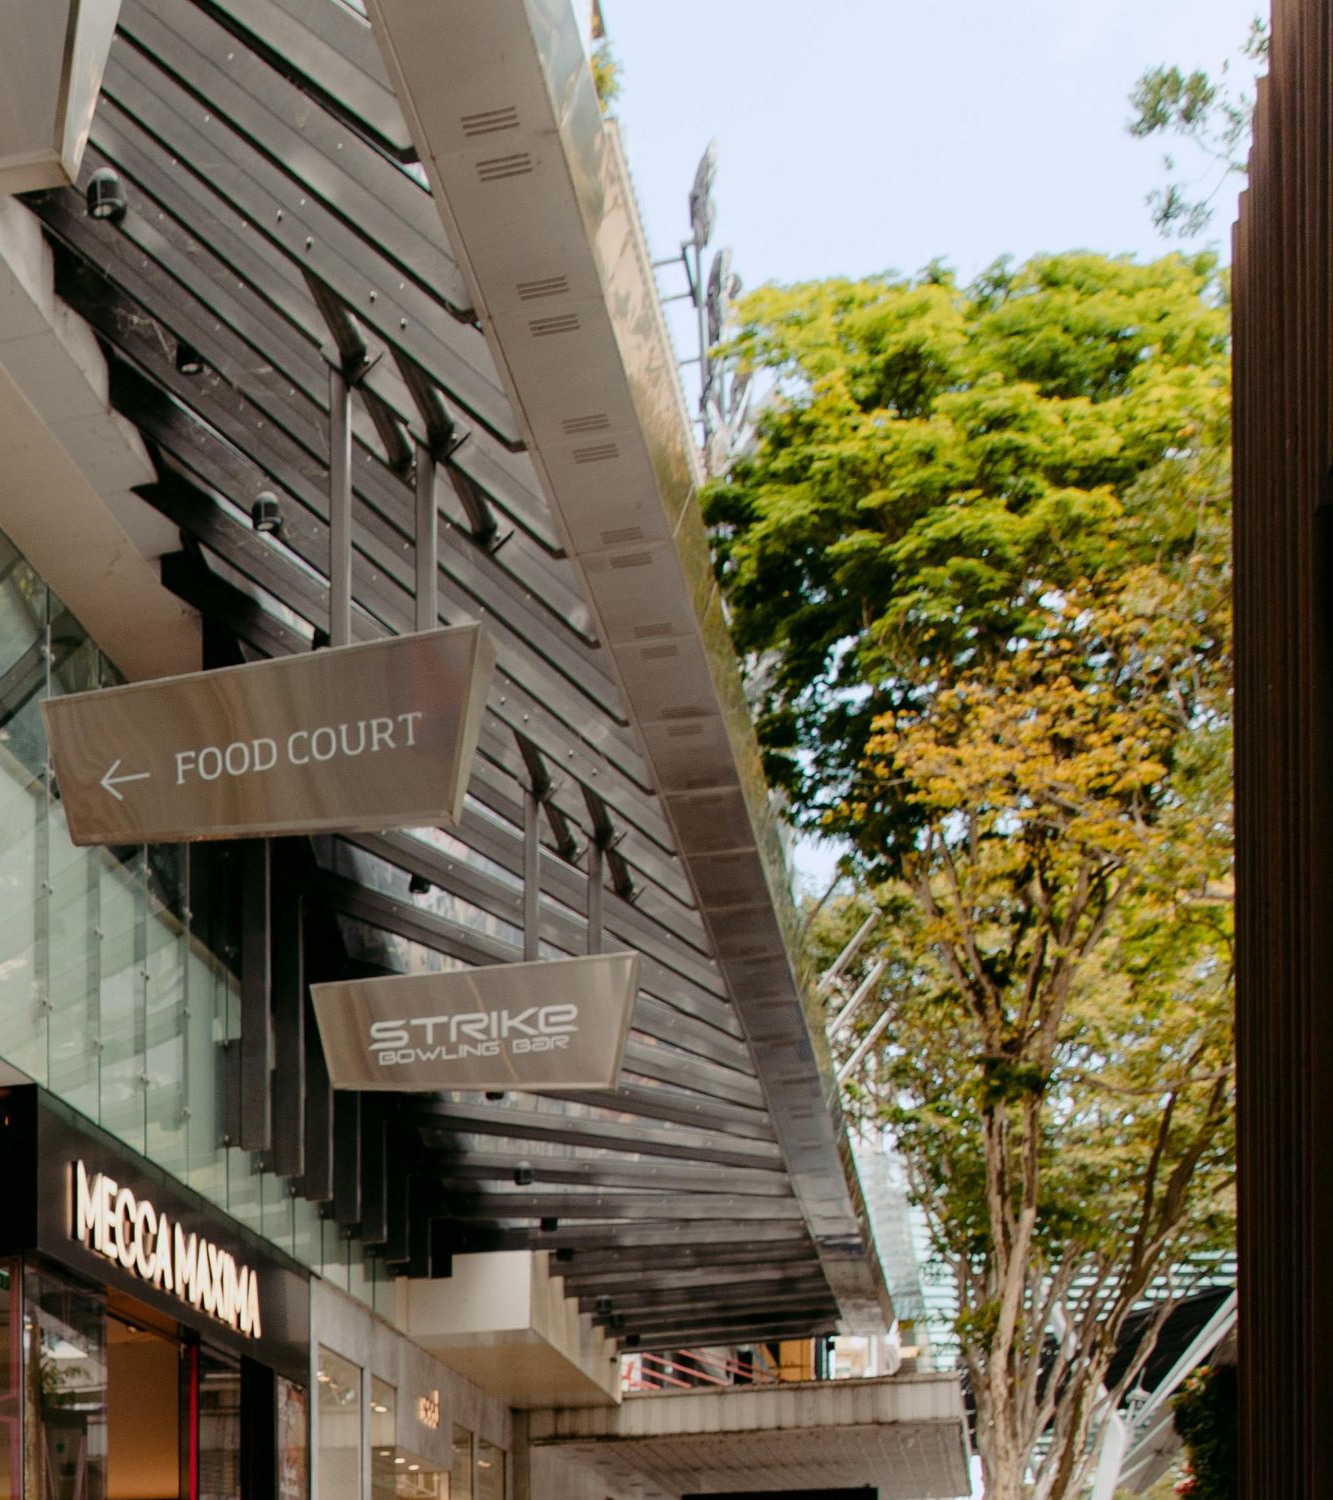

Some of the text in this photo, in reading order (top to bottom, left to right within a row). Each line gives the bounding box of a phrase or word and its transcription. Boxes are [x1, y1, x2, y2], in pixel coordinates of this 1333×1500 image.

[175, 711, 423, 786] FOOD COURT
[368, 1003, 580, 1051] STRIKE
[378, 1033, 571, 1066] BOWLING BAR
[69, 1159, 262, 1339] MECCA MAXIMA
